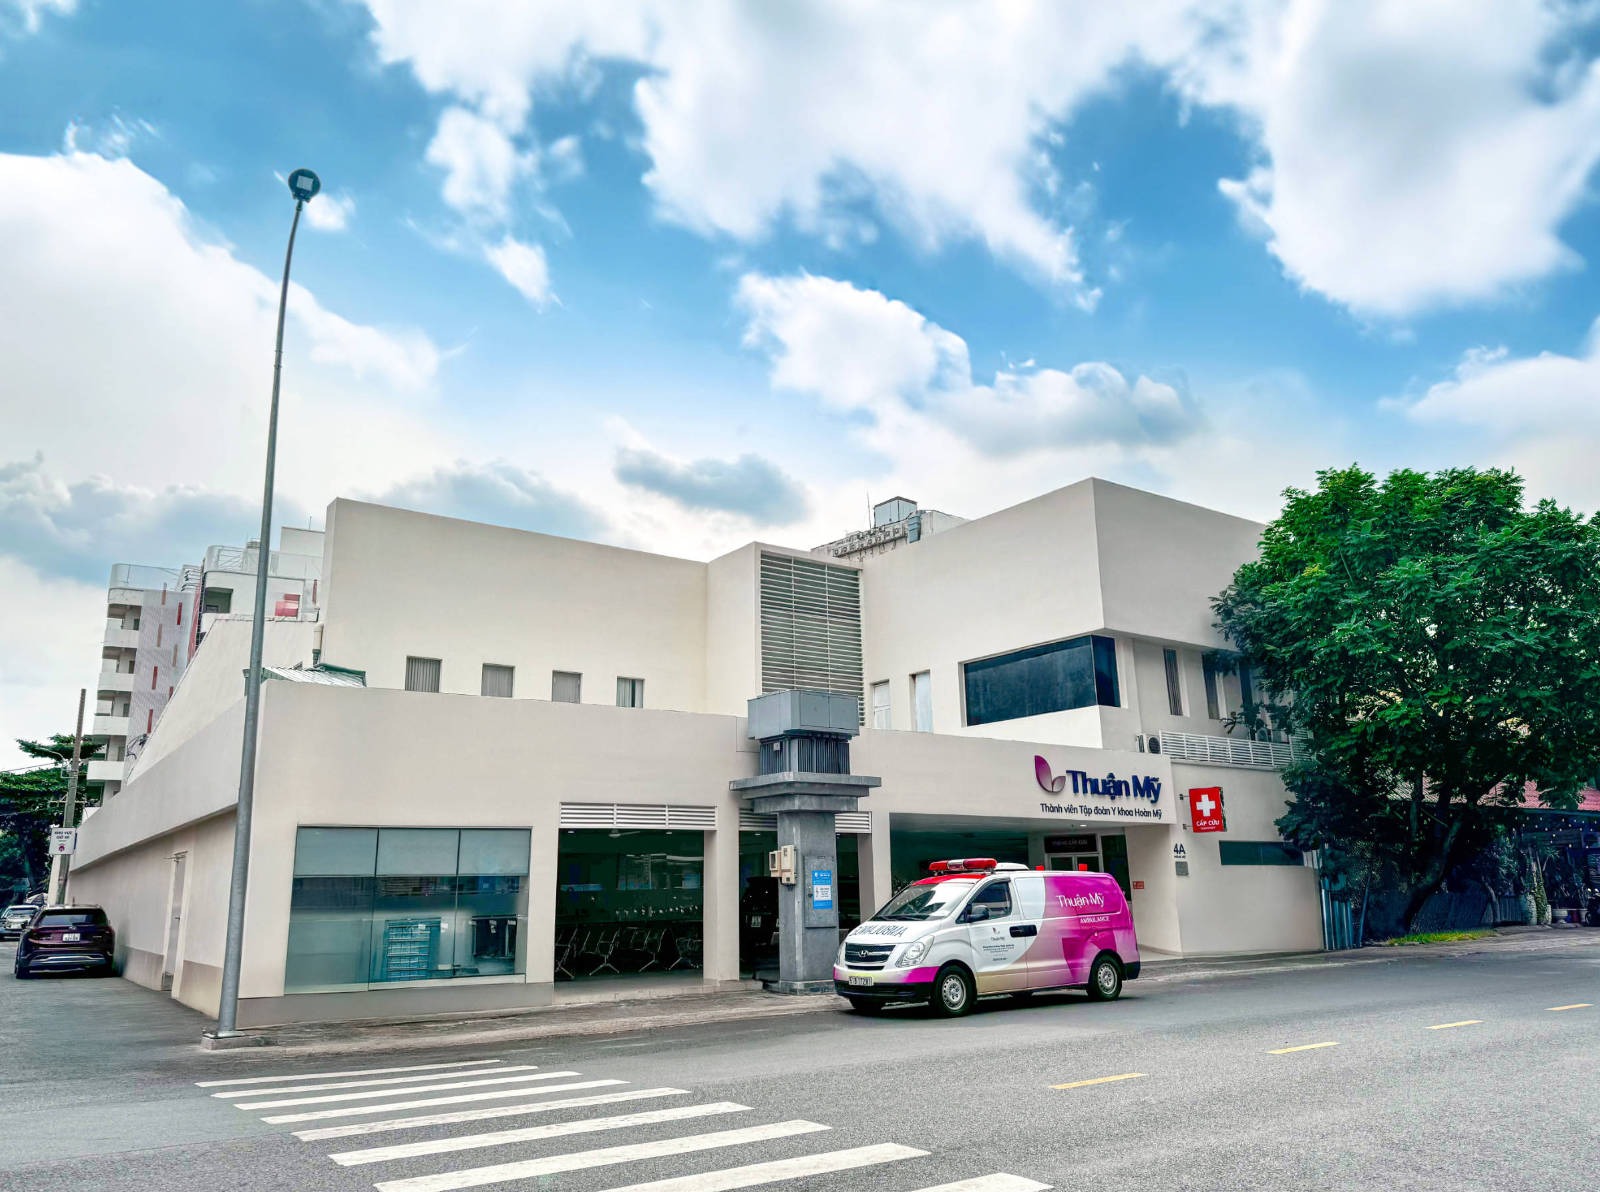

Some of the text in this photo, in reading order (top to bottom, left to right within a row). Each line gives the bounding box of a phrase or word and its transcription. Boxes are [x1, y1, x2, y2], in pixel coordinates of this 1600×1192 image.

[1066, 770, 1162, 804] Thuận Mỹ
[1040, 803, 1062, 813] Thành
[1063, 805, 1078, 814] viên
[1079, 805, 1092, 816] Tập
[1111, 807, 1117, 815] Y
[1118, 807, 1134, 816] khoa
[1135, 808, 1152, 817] Hoàn
[1174, 843, 1185, 854] 4A
[1056, 893, 1089, 908] Thuận
